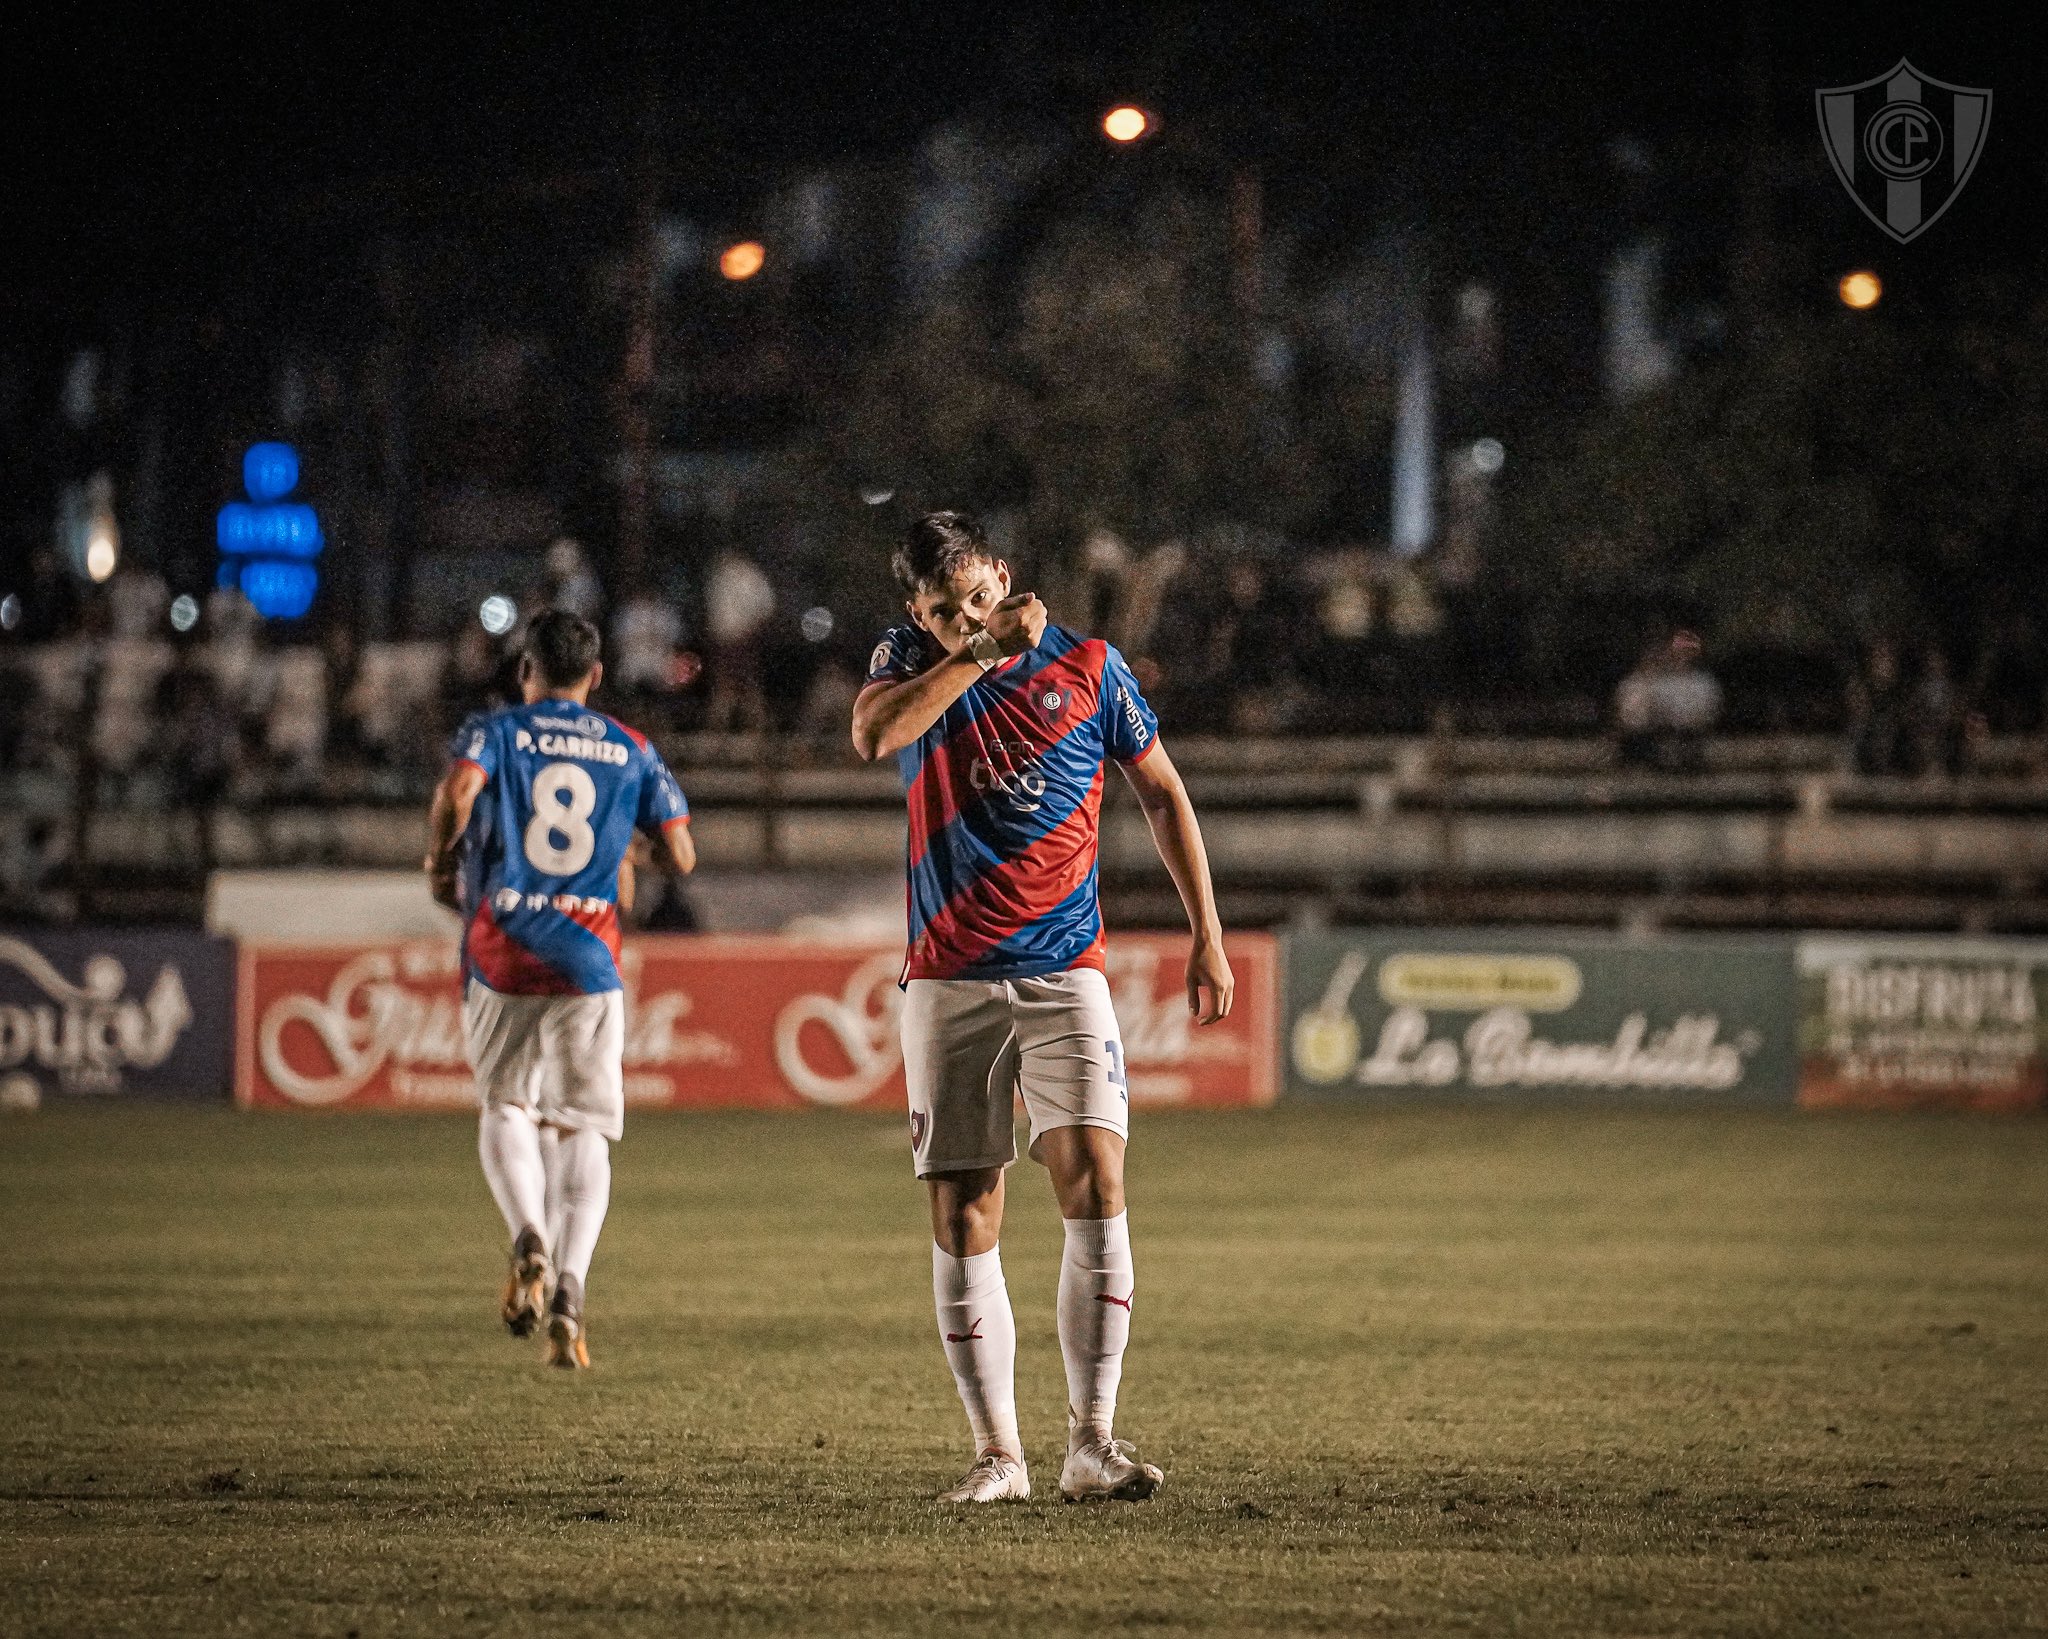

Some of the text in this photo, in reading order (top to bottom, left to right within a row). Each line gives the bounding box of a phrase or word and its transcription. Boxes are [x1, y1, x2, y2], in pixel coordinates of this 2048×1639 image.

[1116, 685, 1149, 749] BRISTOL
[538, 733, 629, 767] CARRIZO
[524, 762, 597, 877] 8
